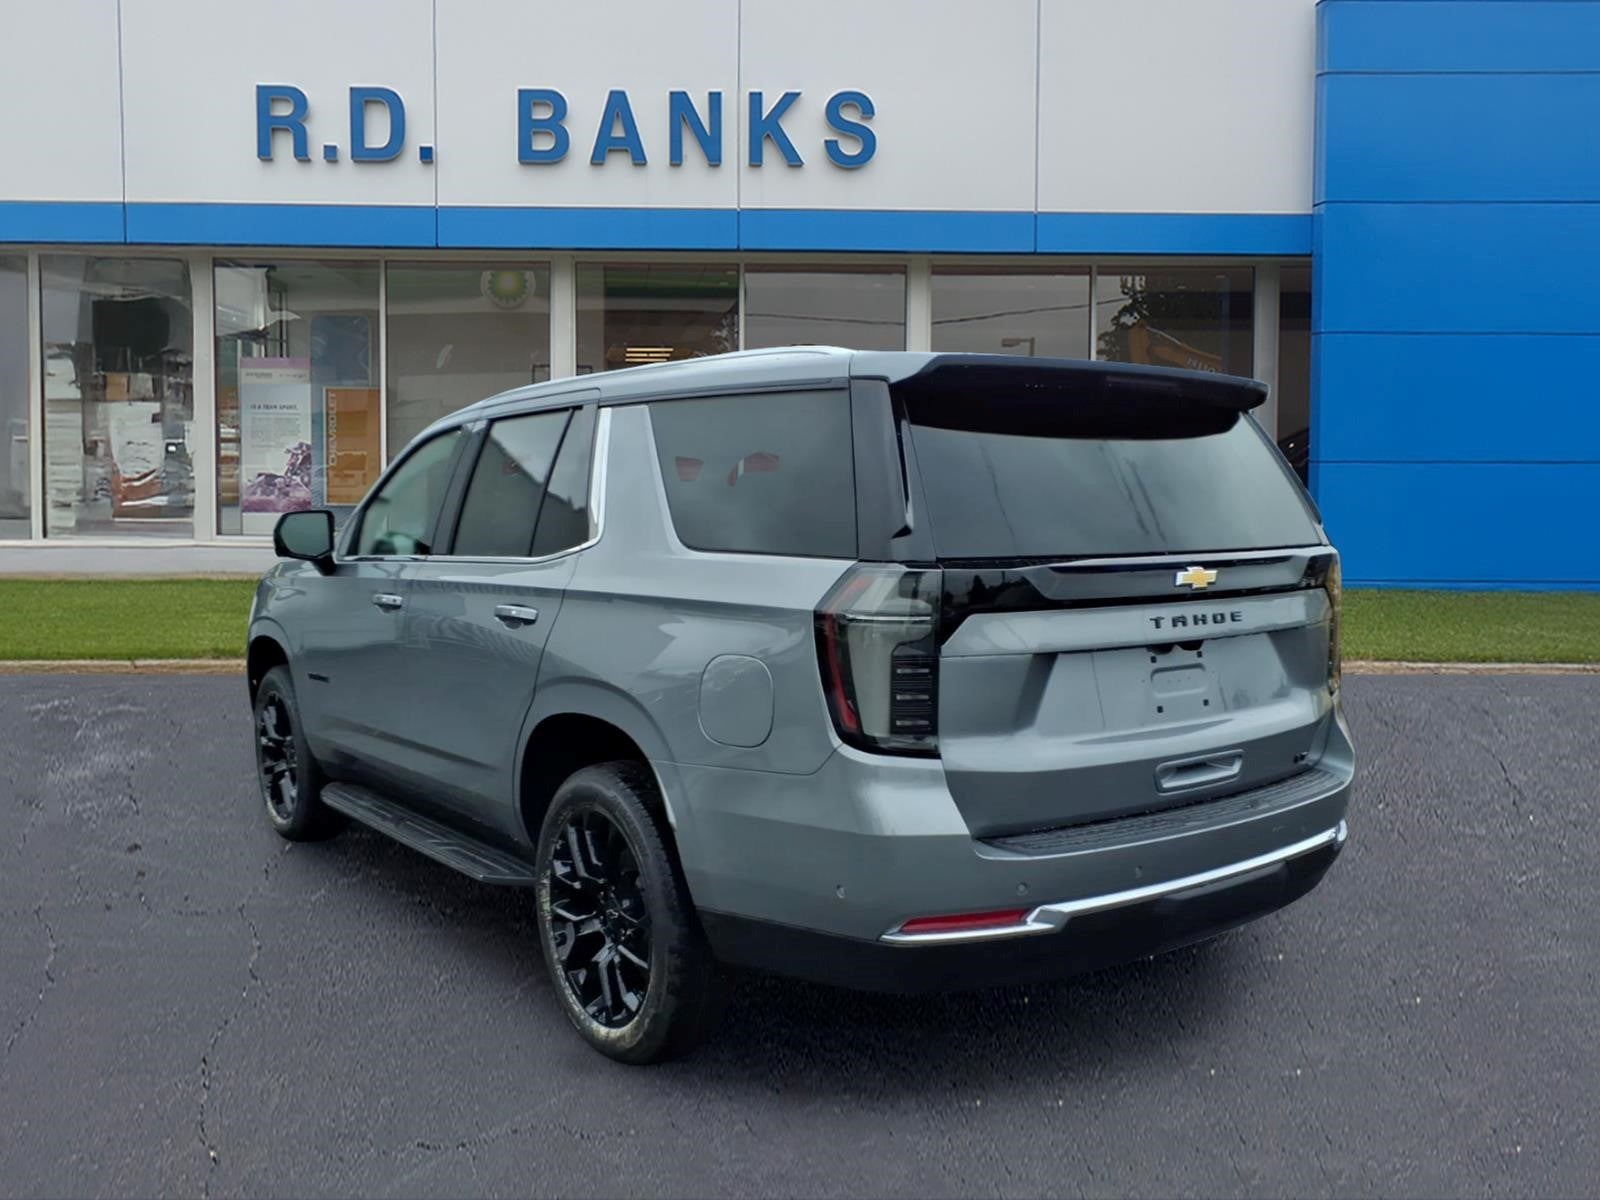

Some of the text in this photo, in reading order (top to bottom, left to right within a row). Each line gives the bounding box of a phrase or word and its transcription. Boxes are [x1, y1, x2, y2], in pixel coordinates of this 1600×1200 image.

[256, 84, 877, 169] R.D. BANKS
[1149, 611, 1242, 629] TAHOE
